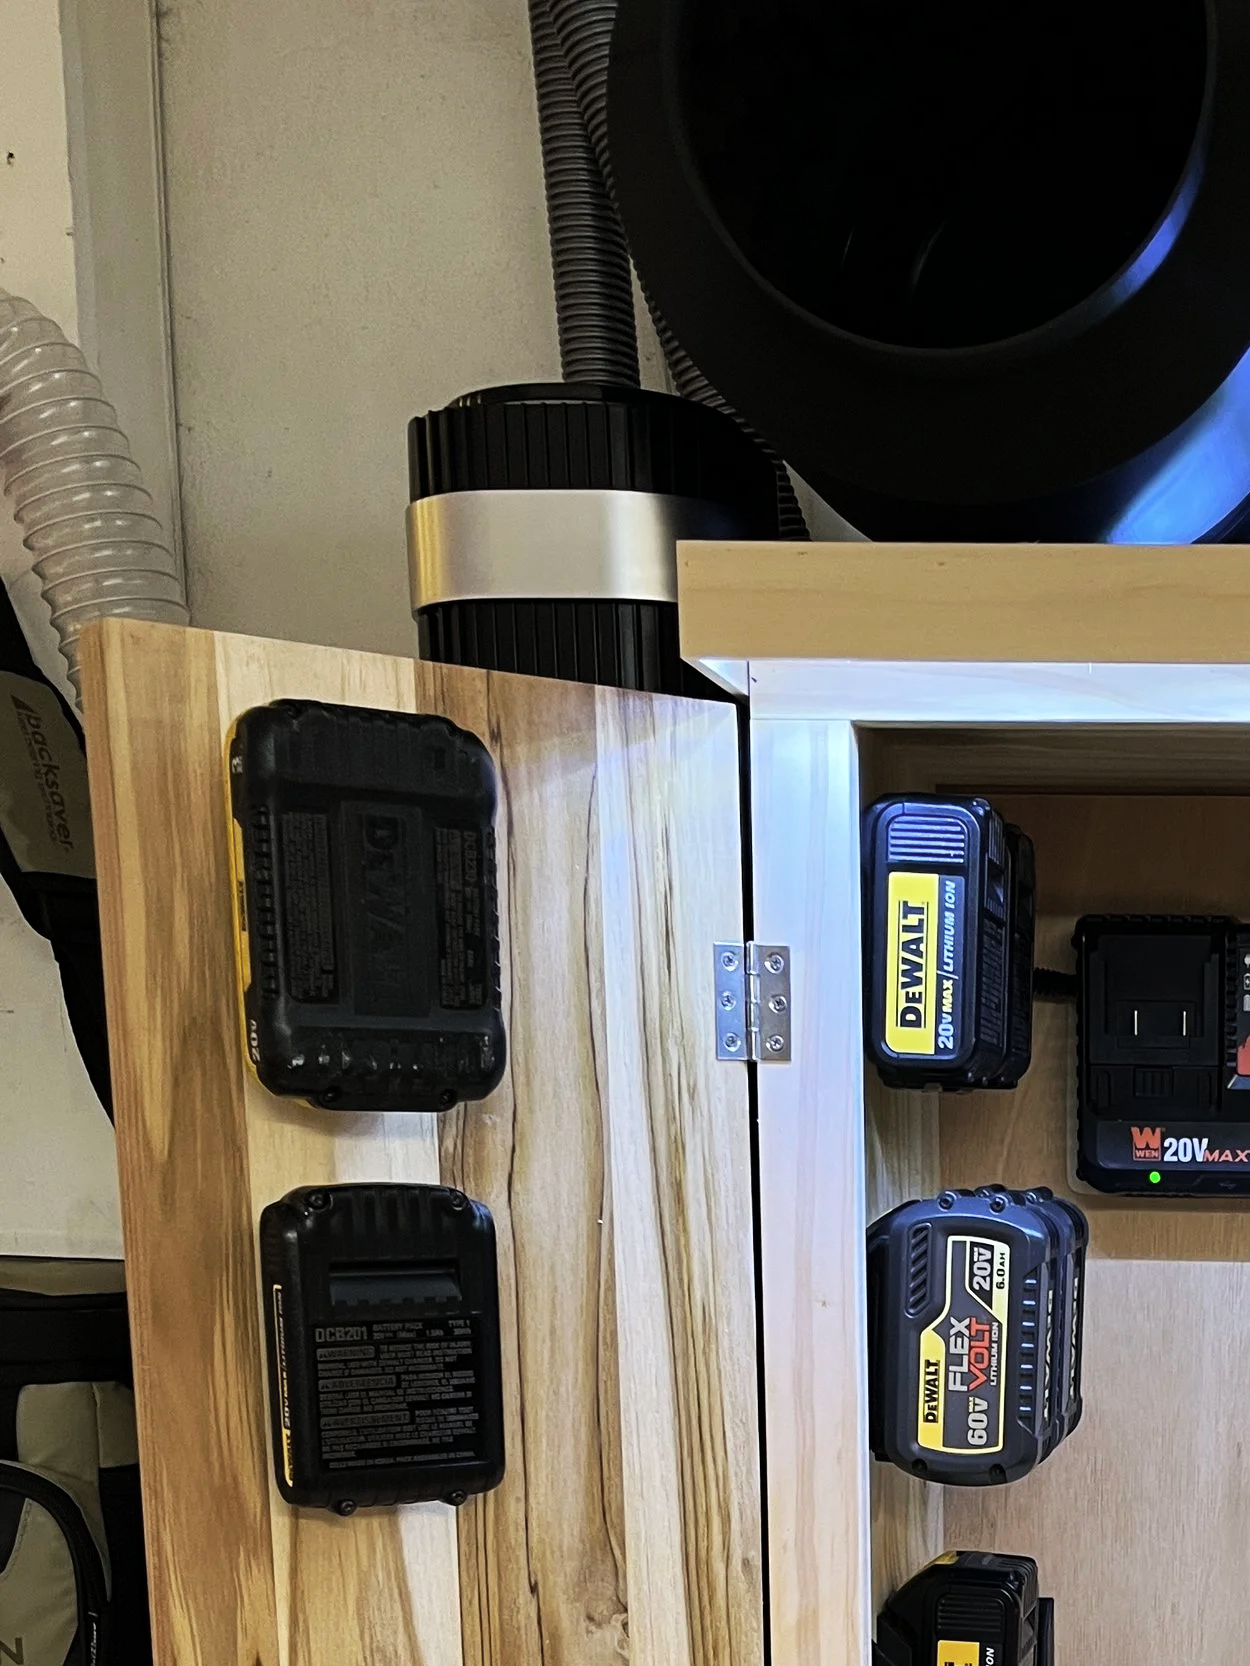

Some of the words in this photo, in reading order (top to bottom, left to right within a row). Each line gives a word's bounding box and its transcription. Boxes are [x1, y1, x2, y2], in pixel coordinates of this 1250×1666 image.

[945, 881, 956, 908] ION
[899, 900, 925, 1028] DEWALT
[1134, 1149, 1159, 1159] WEN
[1164, 1137, 1208, 1162] 20V
[973, 1247, 990, 1292] 20V
[315, 1326, 368, 1343] DCB201
[948, 1317, 970, 1392] FLEX
[968, 1317, 991, 1392] VOLT
[990, 1342, 998, 1386] LITHIUM
[923, 1360, 940, 1424] DEWALT
[967, 1397, 989, 1446] 60V
